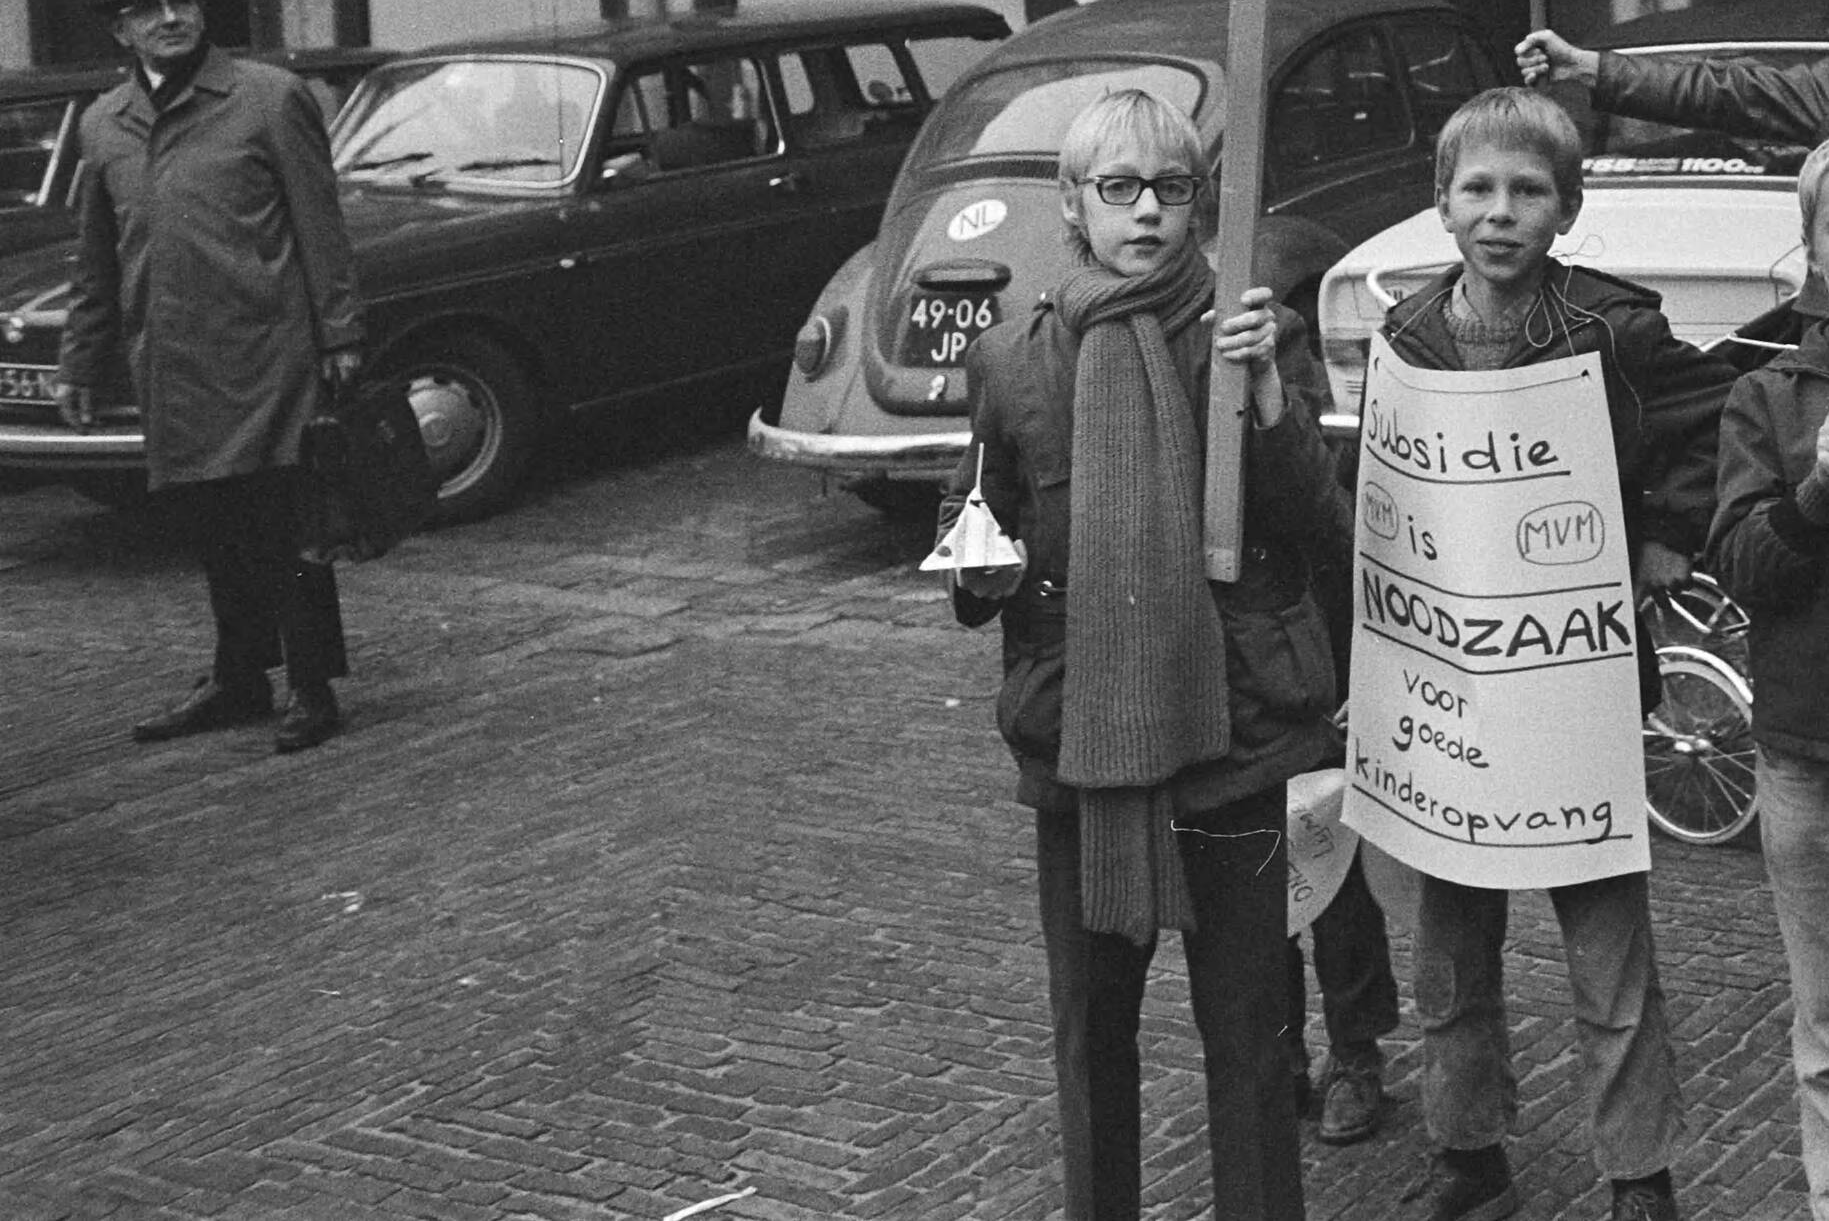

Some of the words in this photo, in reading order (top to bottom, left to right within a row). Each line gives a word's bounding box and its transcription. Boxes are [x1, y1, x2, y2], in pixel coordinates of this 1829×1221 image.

[958, 205, 997, 236] NL
[930, 333, 968, 363] JP
[1367, 398, 1559, 474] Subsidie
[1407, 514, 1438, 561] is
[1523, 510, 1595, 555] MVM
[1362, 568, 1632, 657] NOODZAAK
[1402, 669, 1469, 718] voor
[1391, 714, 1490, 769] goede
[1355, 737, 1613, 845] kinderopvang
